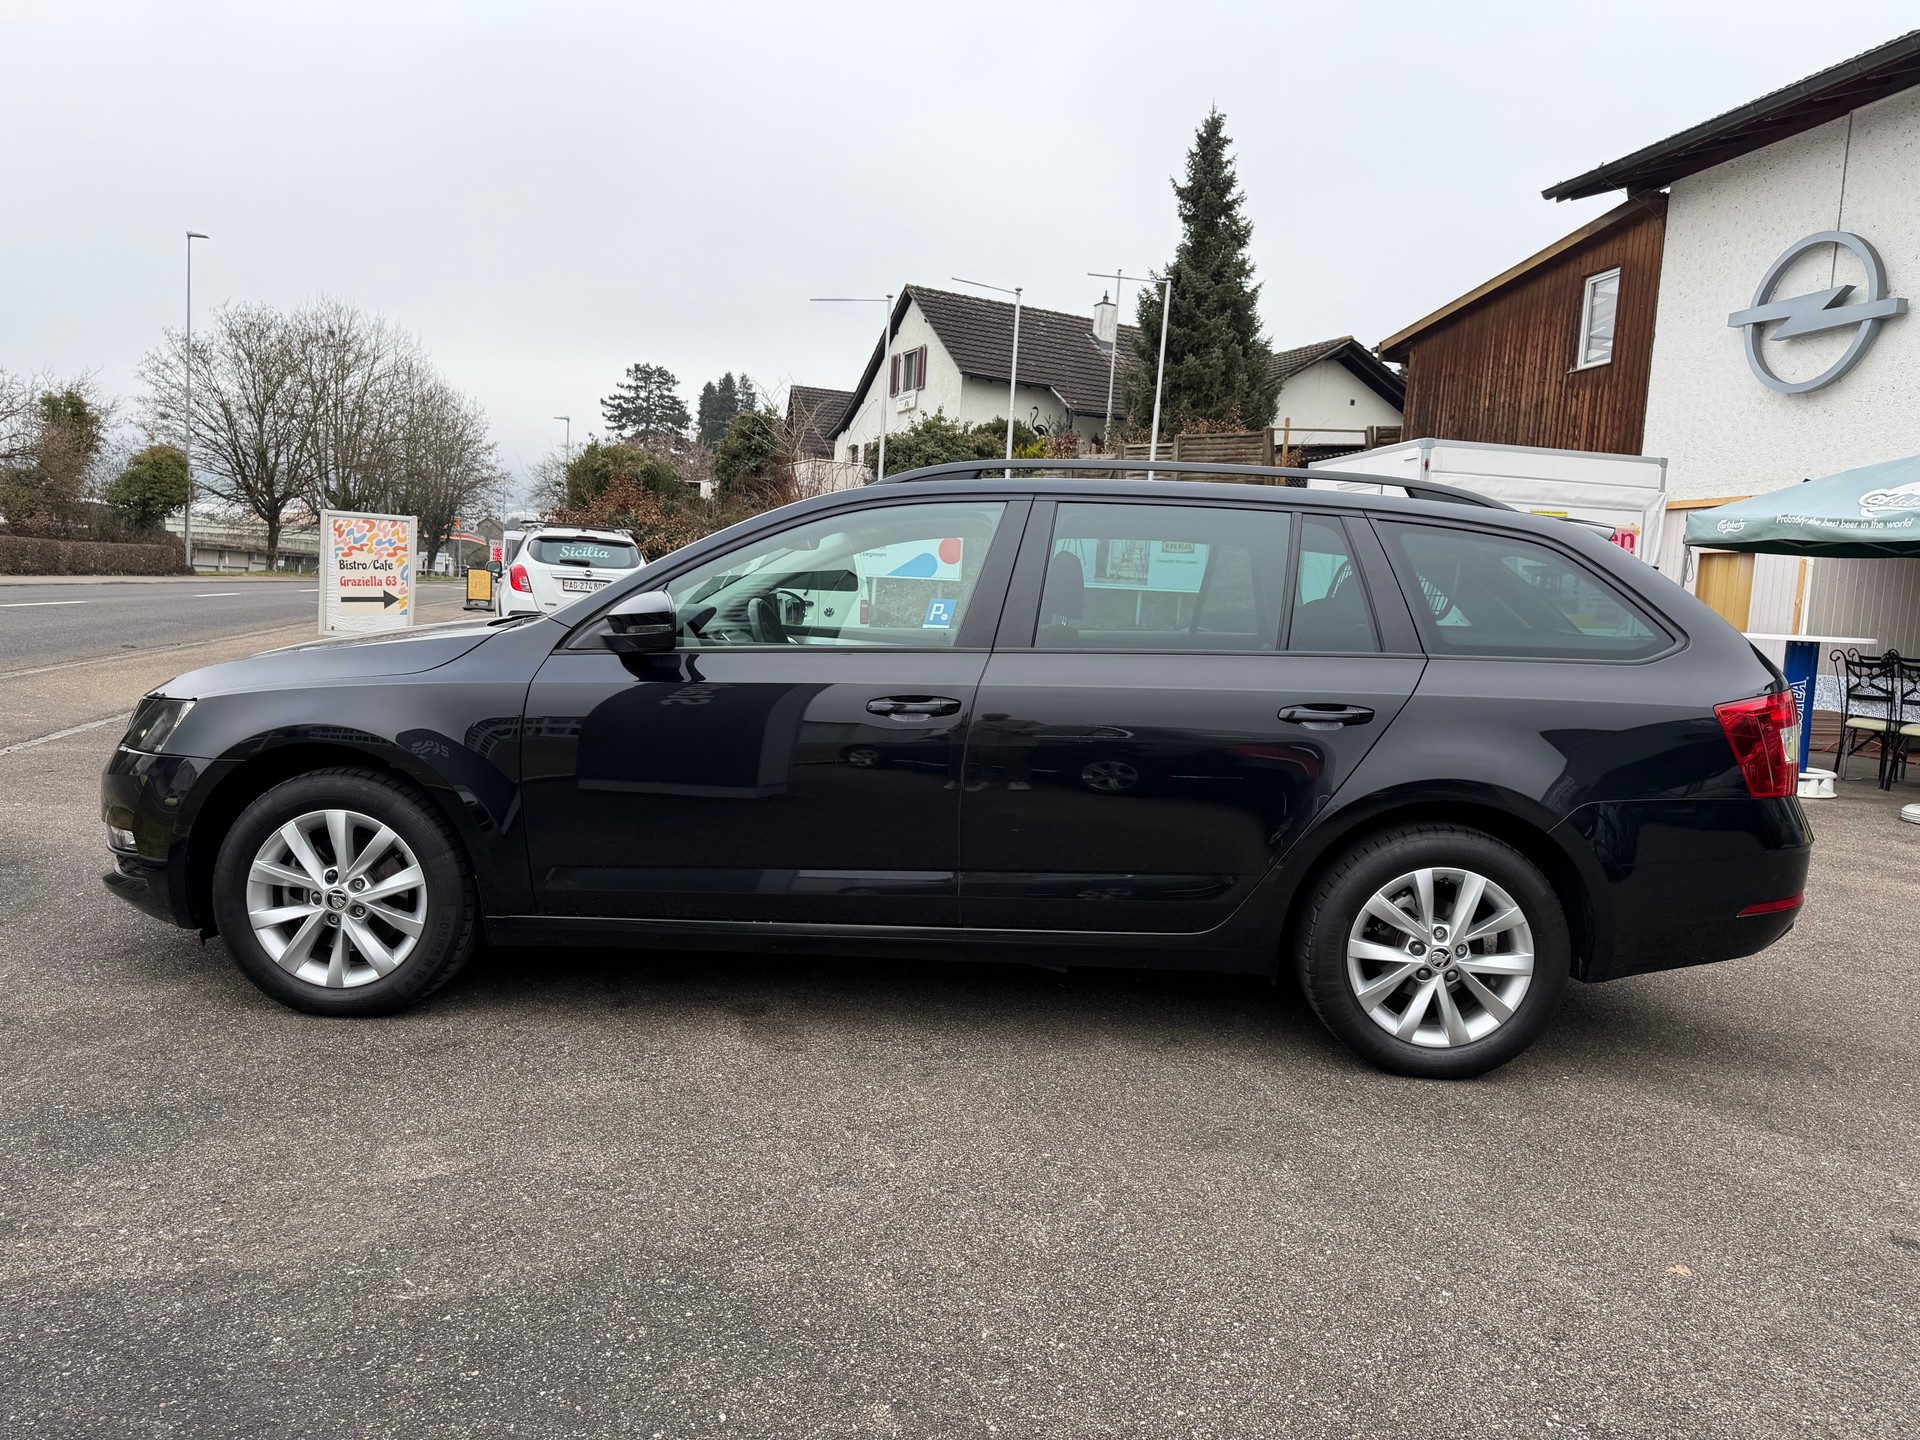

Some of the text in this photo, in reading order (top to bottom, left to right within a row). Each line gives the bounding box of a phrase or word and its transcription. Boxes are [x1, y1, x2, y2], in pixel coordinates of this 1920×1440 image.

[1776, 513, 1808, 526] Probably
[1821, 518, 1840, 528] best
[1840, 518, 1858, 528] beer
[1860, 519, 1868, 529] in
[1870, 518, 1884, 529] the
[1886, 517, 1914, 528] world
[1165, 542, 1192, 550] IKEA
[559, 546, 610, 559] Sicilia
[339, 559, 394, 571] Bistro/Cafe
[340, 576, 397, 587] Graziella 63
[929, 603, 944, 621] P
